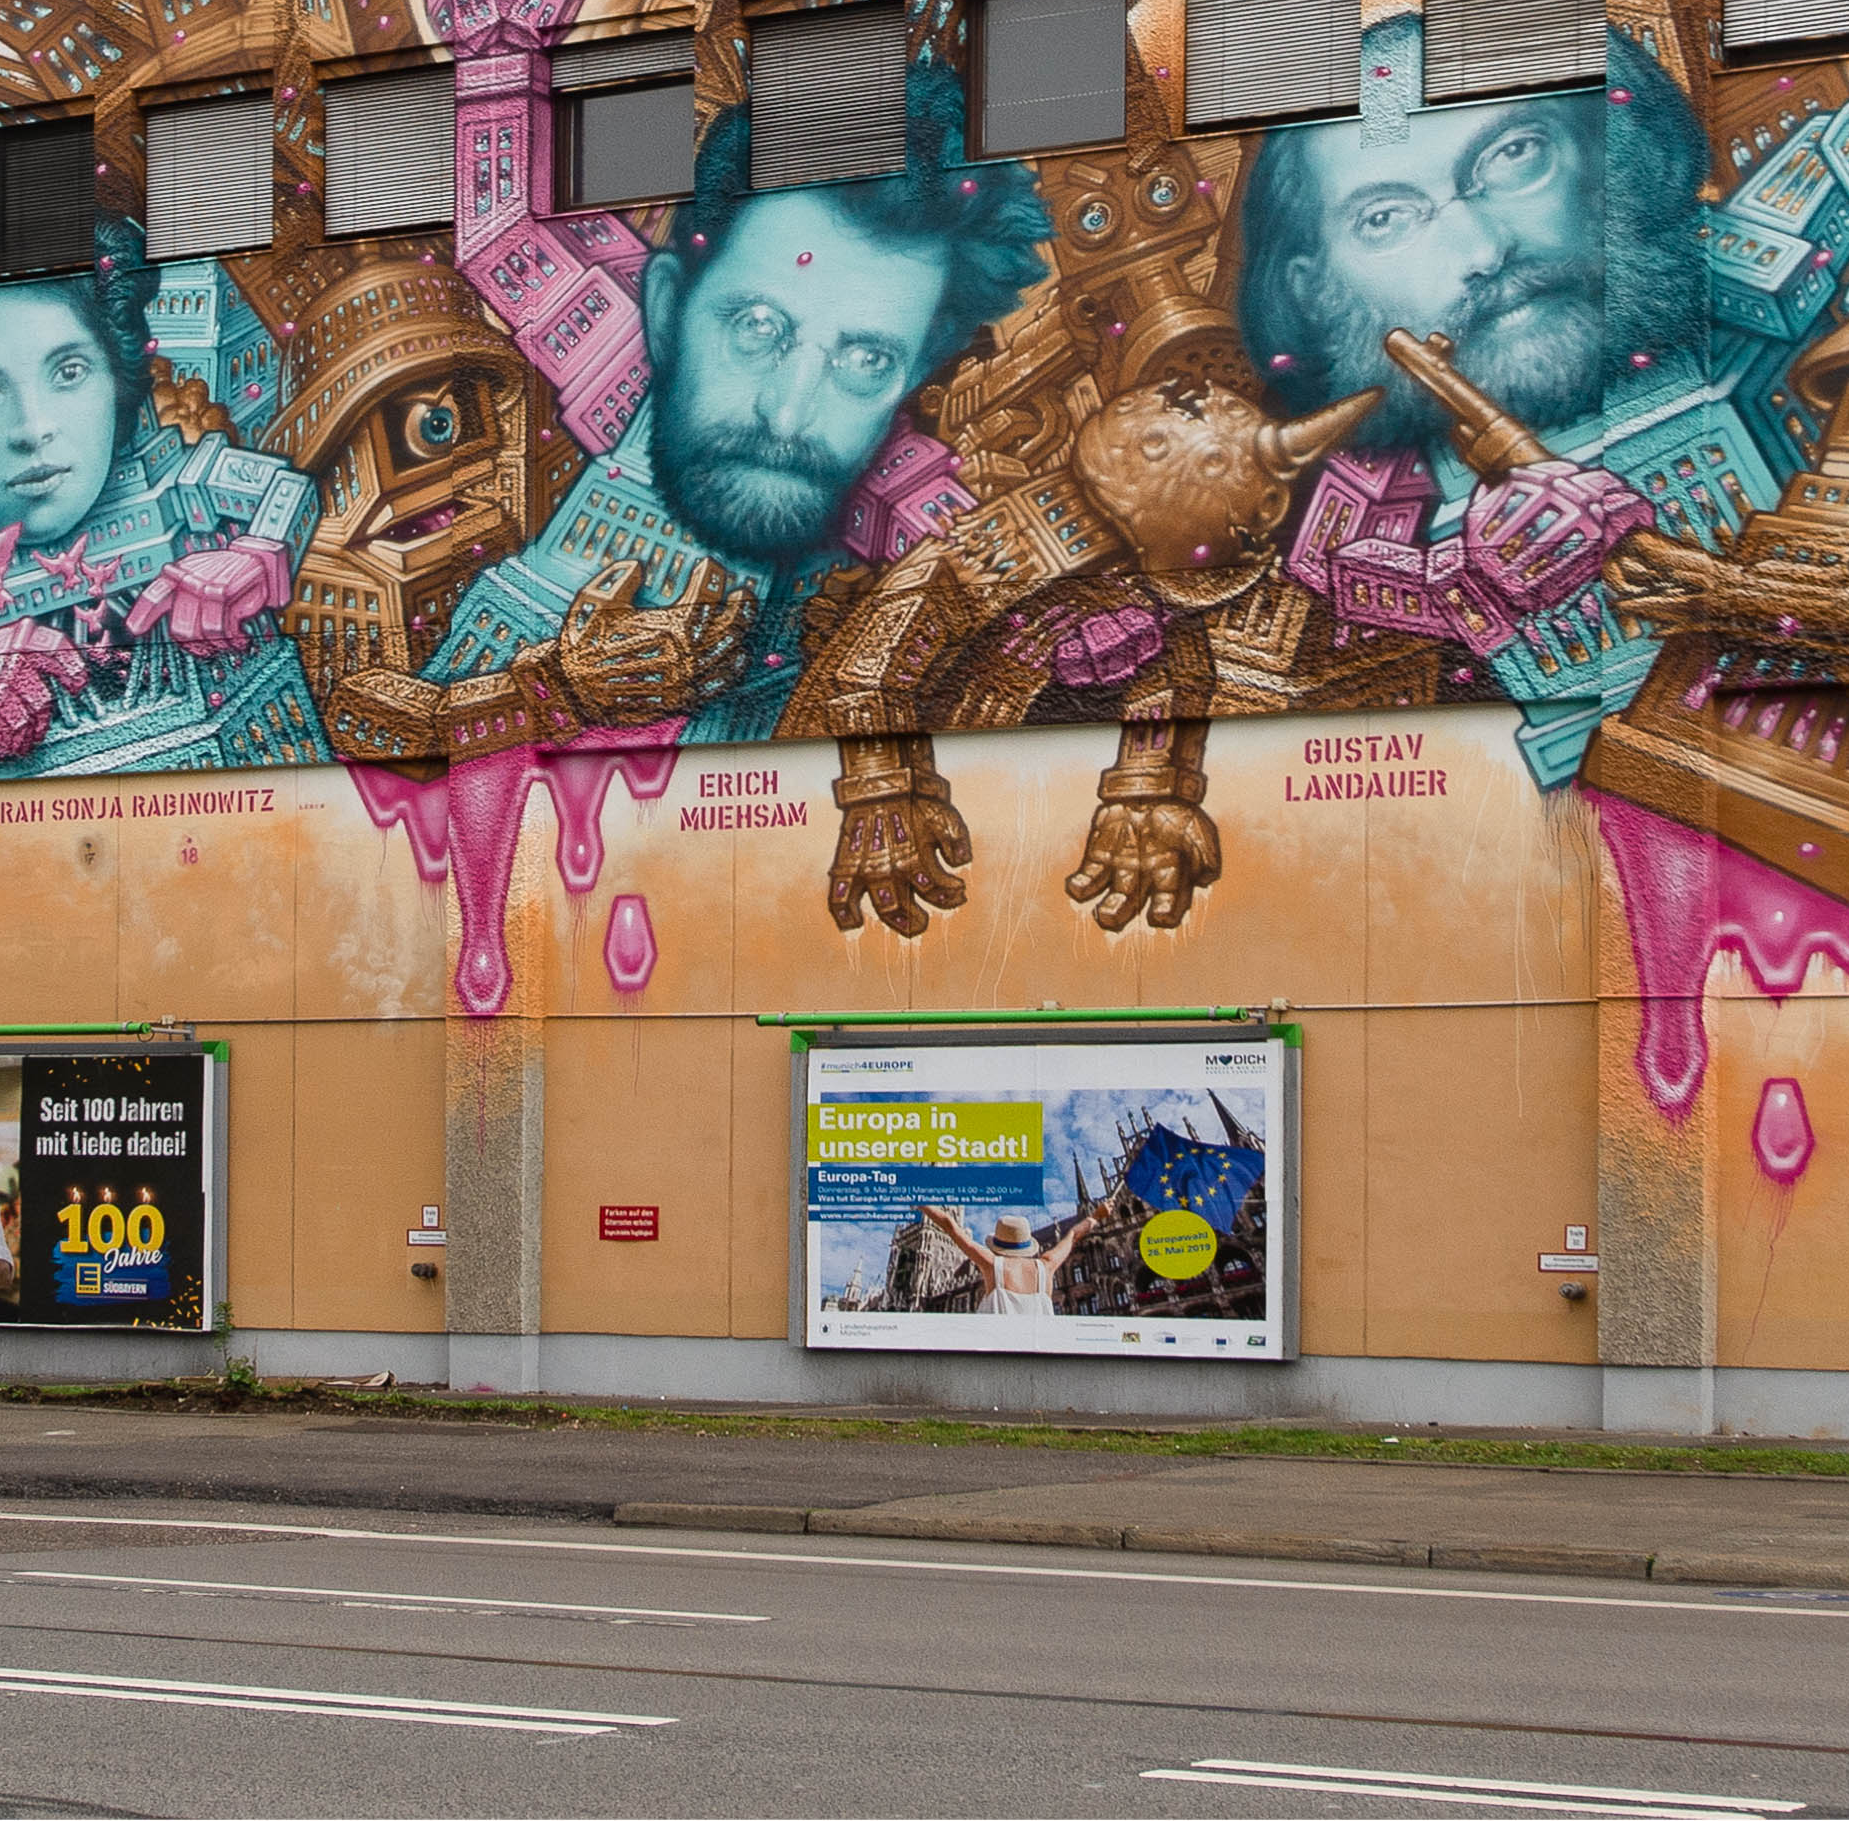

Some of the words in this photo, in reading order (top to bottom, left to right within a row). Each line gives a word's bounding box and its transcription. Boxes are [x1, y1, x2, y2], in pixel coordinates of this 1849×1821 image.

[1304, 734, 1423, 765] GUSTAV
[700, 770, 778, 798] ERICH
[1285, 770, 1447, 802] LANDAUER
[52, 796, 123, 821] SONJA
[132, 788, 275, 818] RABINOWITZ
[680, 802, 807, 831] MUEHSAM
[180, 847, 199, 865] 18
[39, 1096, 79, 1122] Seit
[82, 1097, 115, 1122] 100
[118, 1096, 184, 1122] Jahren
[819, 1107, 921, 1135] Europa
[931, 1106, 957, 1130] in
[35, 1131, 68, 1156] mit
[72, 1131, 122, 1156] Liebe
[126, 1131, 187, 1157] dabei!
[819, 1140, 929, 1159] unserer
[937, 1134, 1029, 1159] Stadt!
[818, 1170, 897, 1185] Europa-Tag
[817, 1194, 835, 1203] Was
[849, 1194, 878, 1204] Europa
[917, 1195, 944, 1203] Finden
[57, 1203, 165, 1254] 100
[103, 1246, 163, 1274] Jahre
